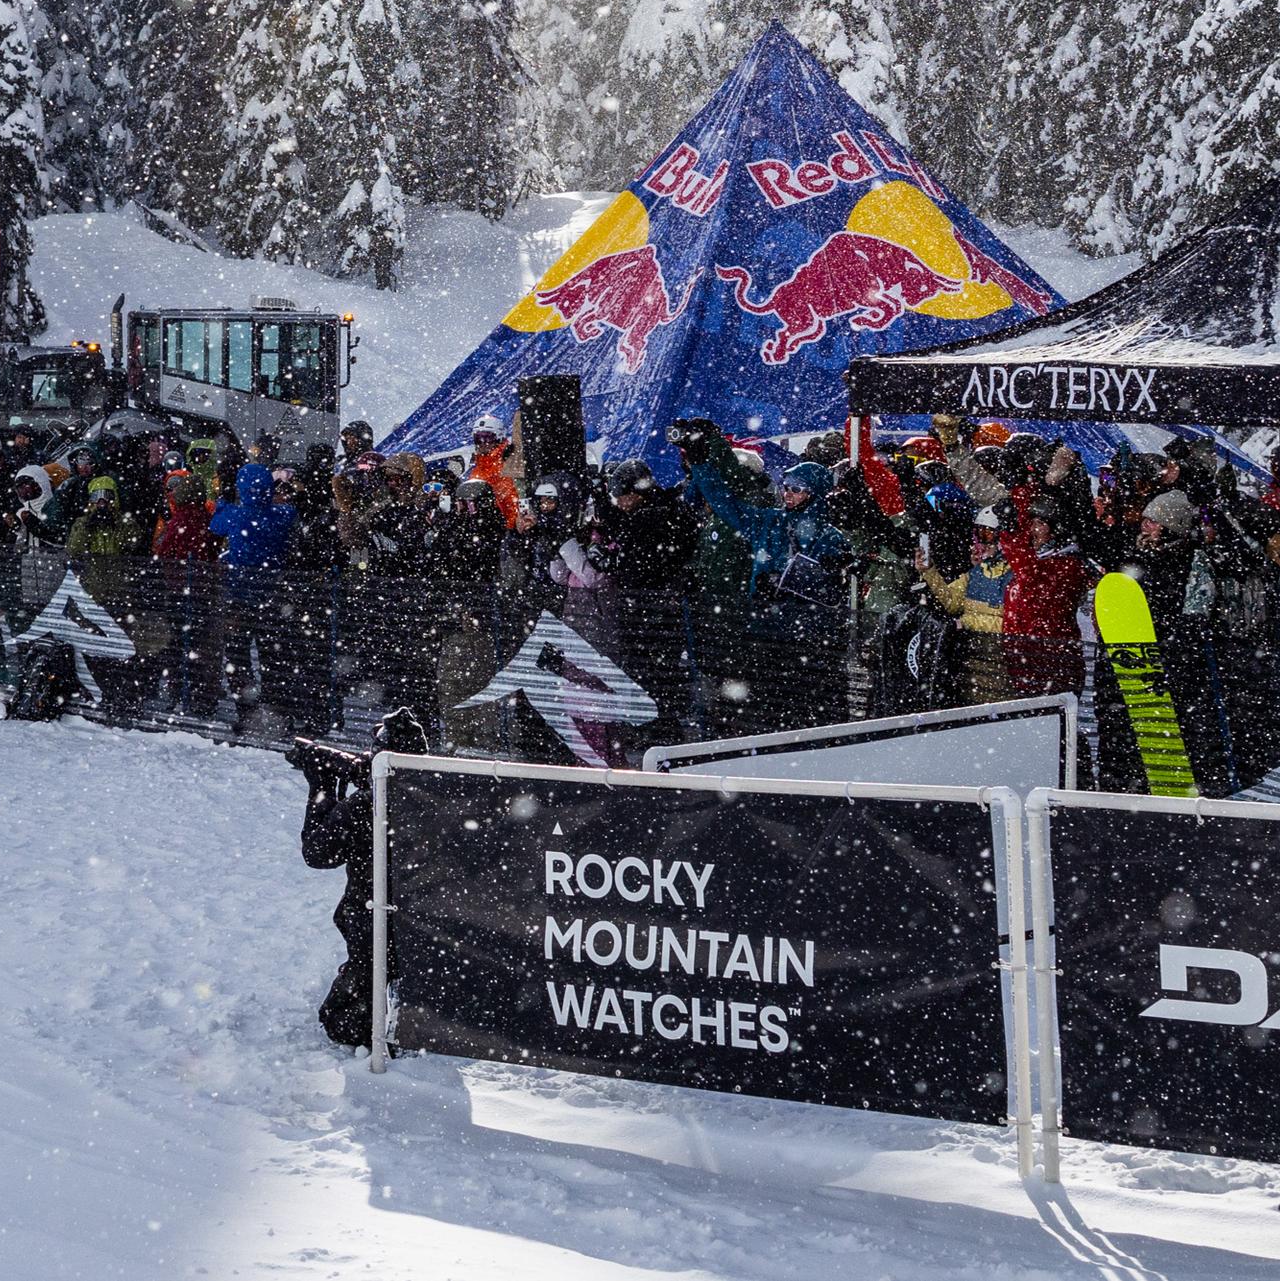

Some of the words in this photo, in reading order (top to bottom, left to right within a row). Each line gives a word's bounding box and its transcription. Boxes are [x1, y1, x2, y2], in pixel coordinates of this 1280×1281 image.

[746, 129, 883, 209] Red
[961, 363, 1158, 412] ARC'TERYX
[545, 850, 715, 908] ROCKY
[544, 915, 815, 988] MOUNTAIN
